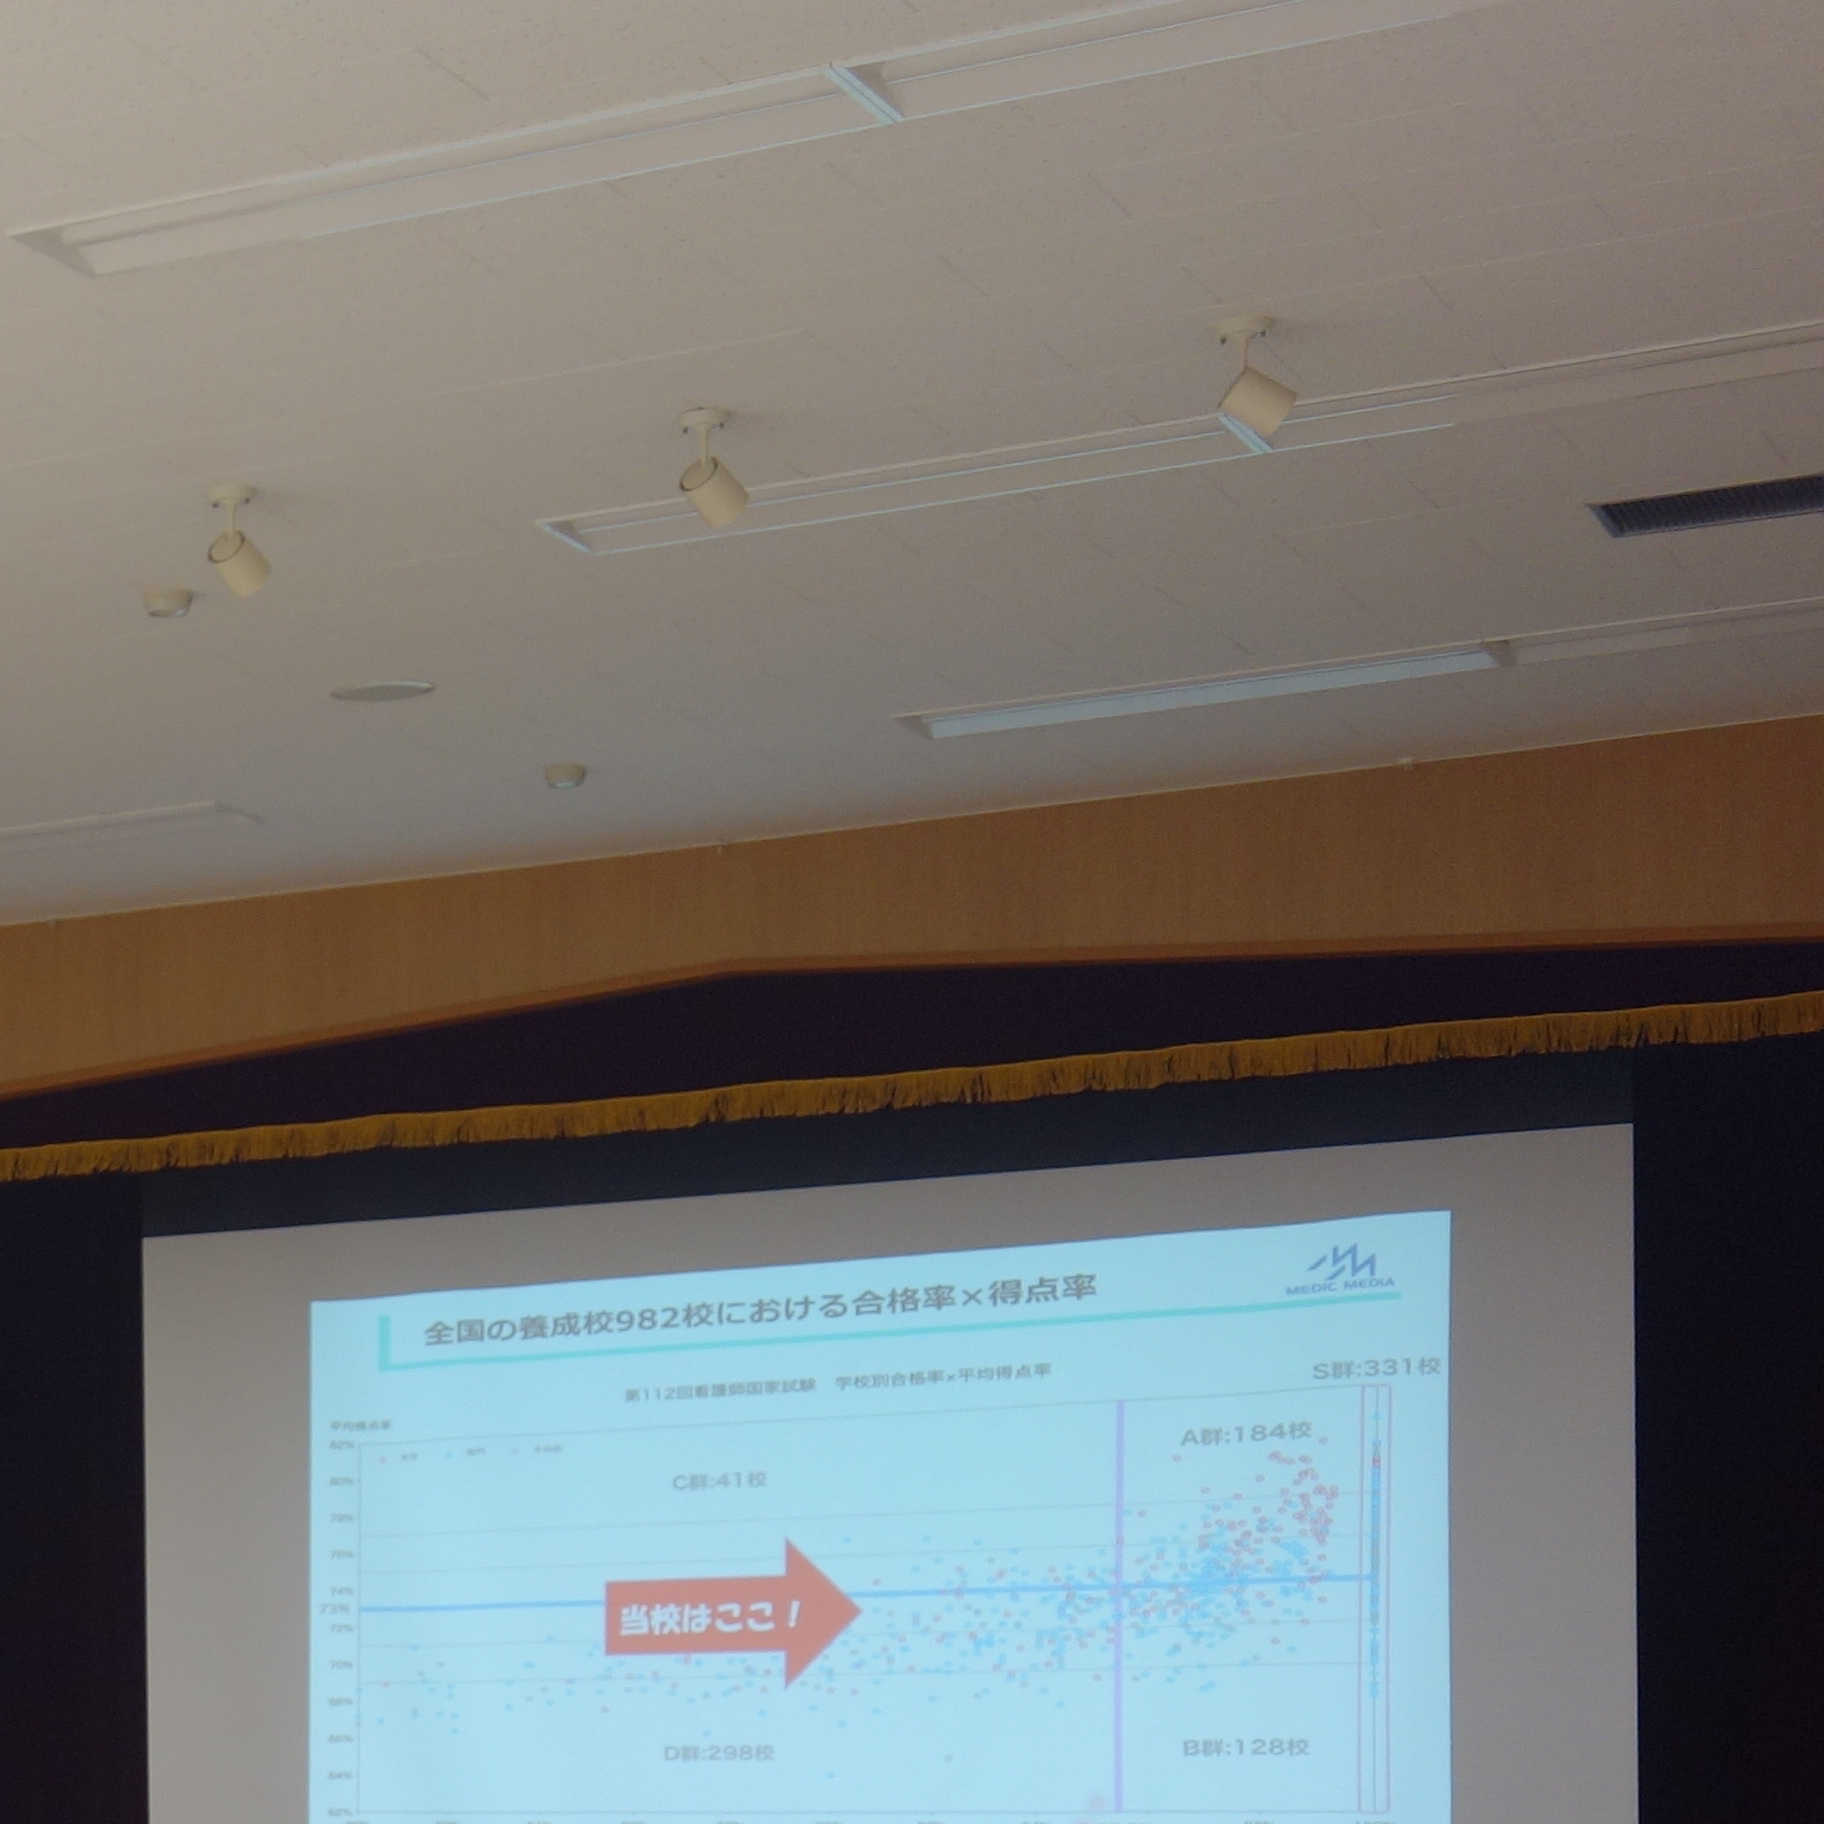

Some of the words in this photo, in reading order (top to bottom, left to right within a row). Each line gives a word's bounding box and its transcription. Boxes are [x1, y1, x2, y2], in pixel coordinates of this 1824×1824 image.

[1285, 1281, 1338, 1296] MEDIC
[1343, 1276, 1396, 1290] MEDIA
[424, 1273, 1098, 1347] 全国の養成校982校における合格率×得点率
[1312, 1356, 1443, 1381] S群:331校
[1180, 1420, 1314, 1447] A群:184校
[672, 1470, 768, 1492] C群:41校
[320, 1603, 351, 1615] 73%
[1182, 1737, 1310, 1758] B群:128校
